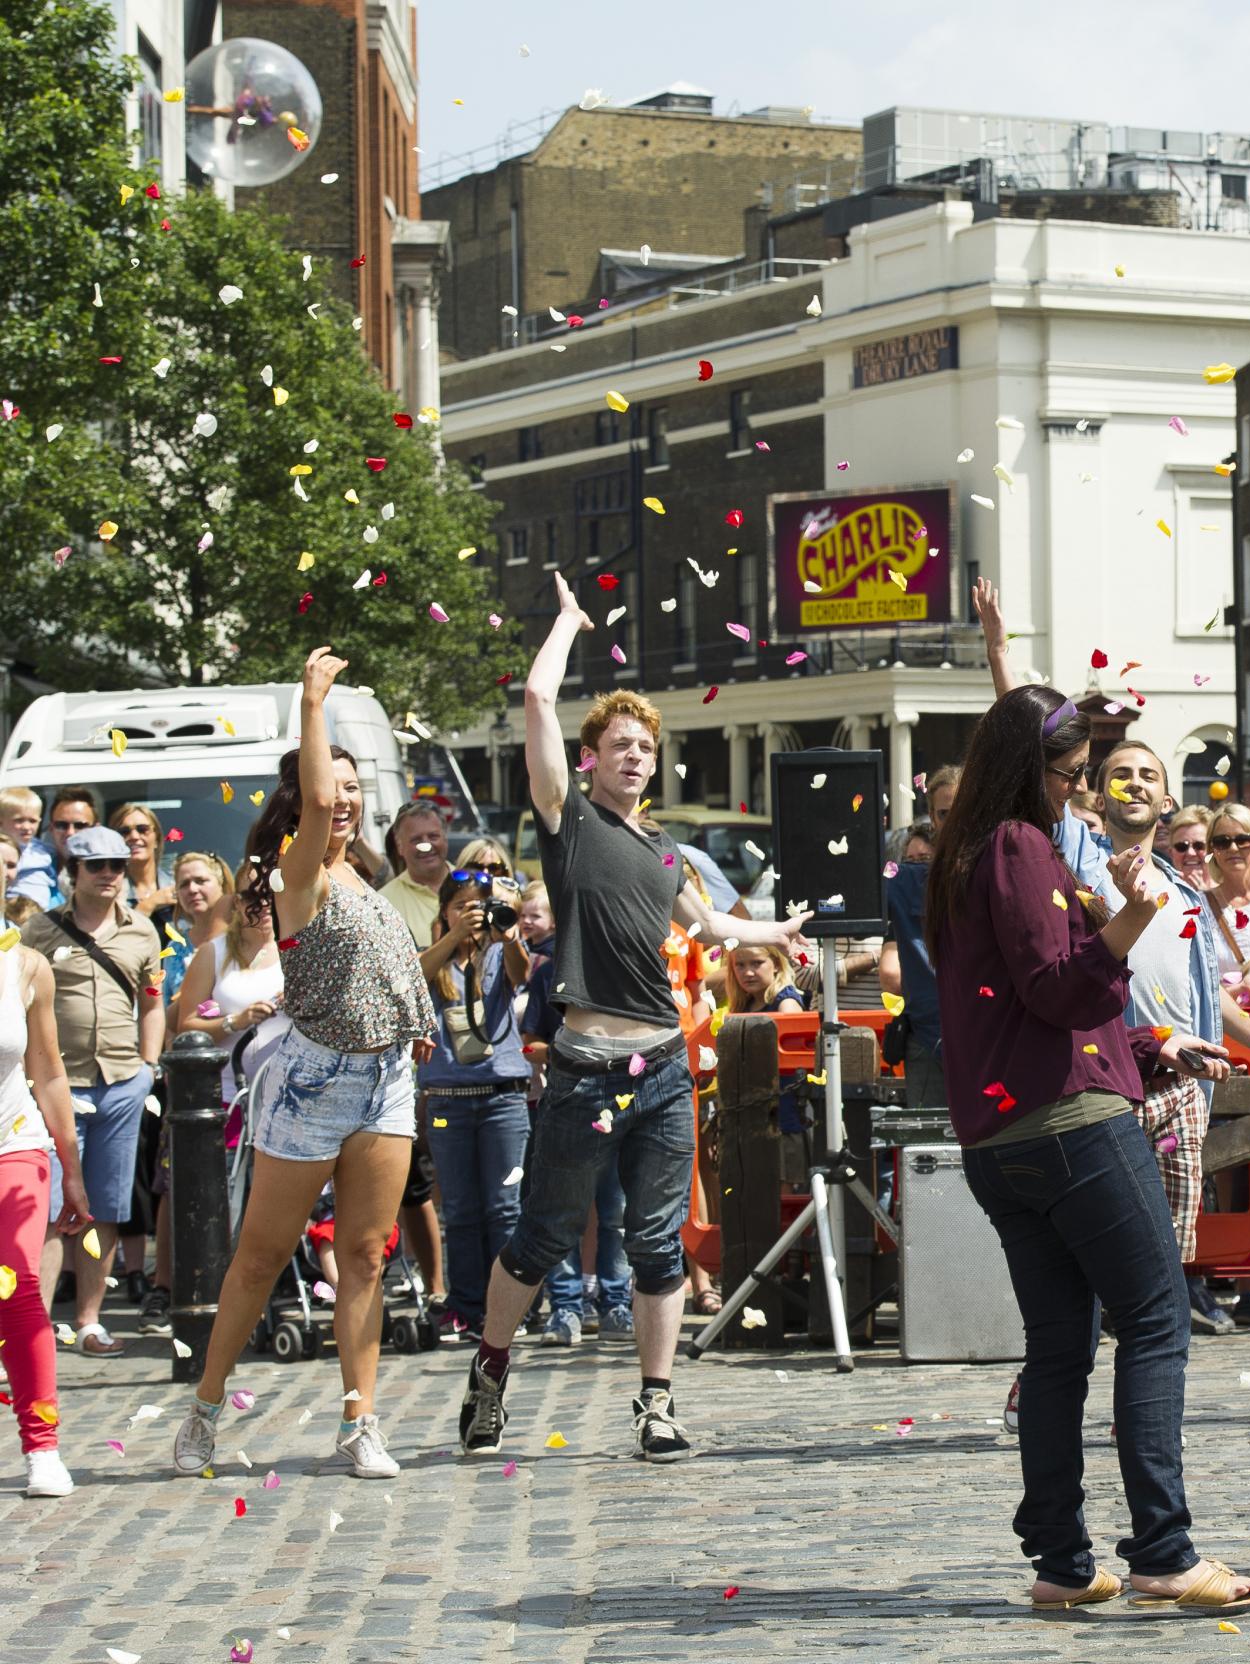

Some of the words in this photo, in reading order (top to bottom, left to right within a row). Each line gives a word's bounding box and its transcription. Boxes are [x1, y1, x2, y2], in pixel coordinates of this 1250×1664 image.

[853, 335, 905, 369] THEATRE
[909, 327, 950, 354] ROYAL
[904, 351, 940, 378] LANE
[803, 508, 918, 589] CHARLIE
[816, 601, 873, 622] CHOCOLATE
[876, 597, 922, 620] FACTORY
